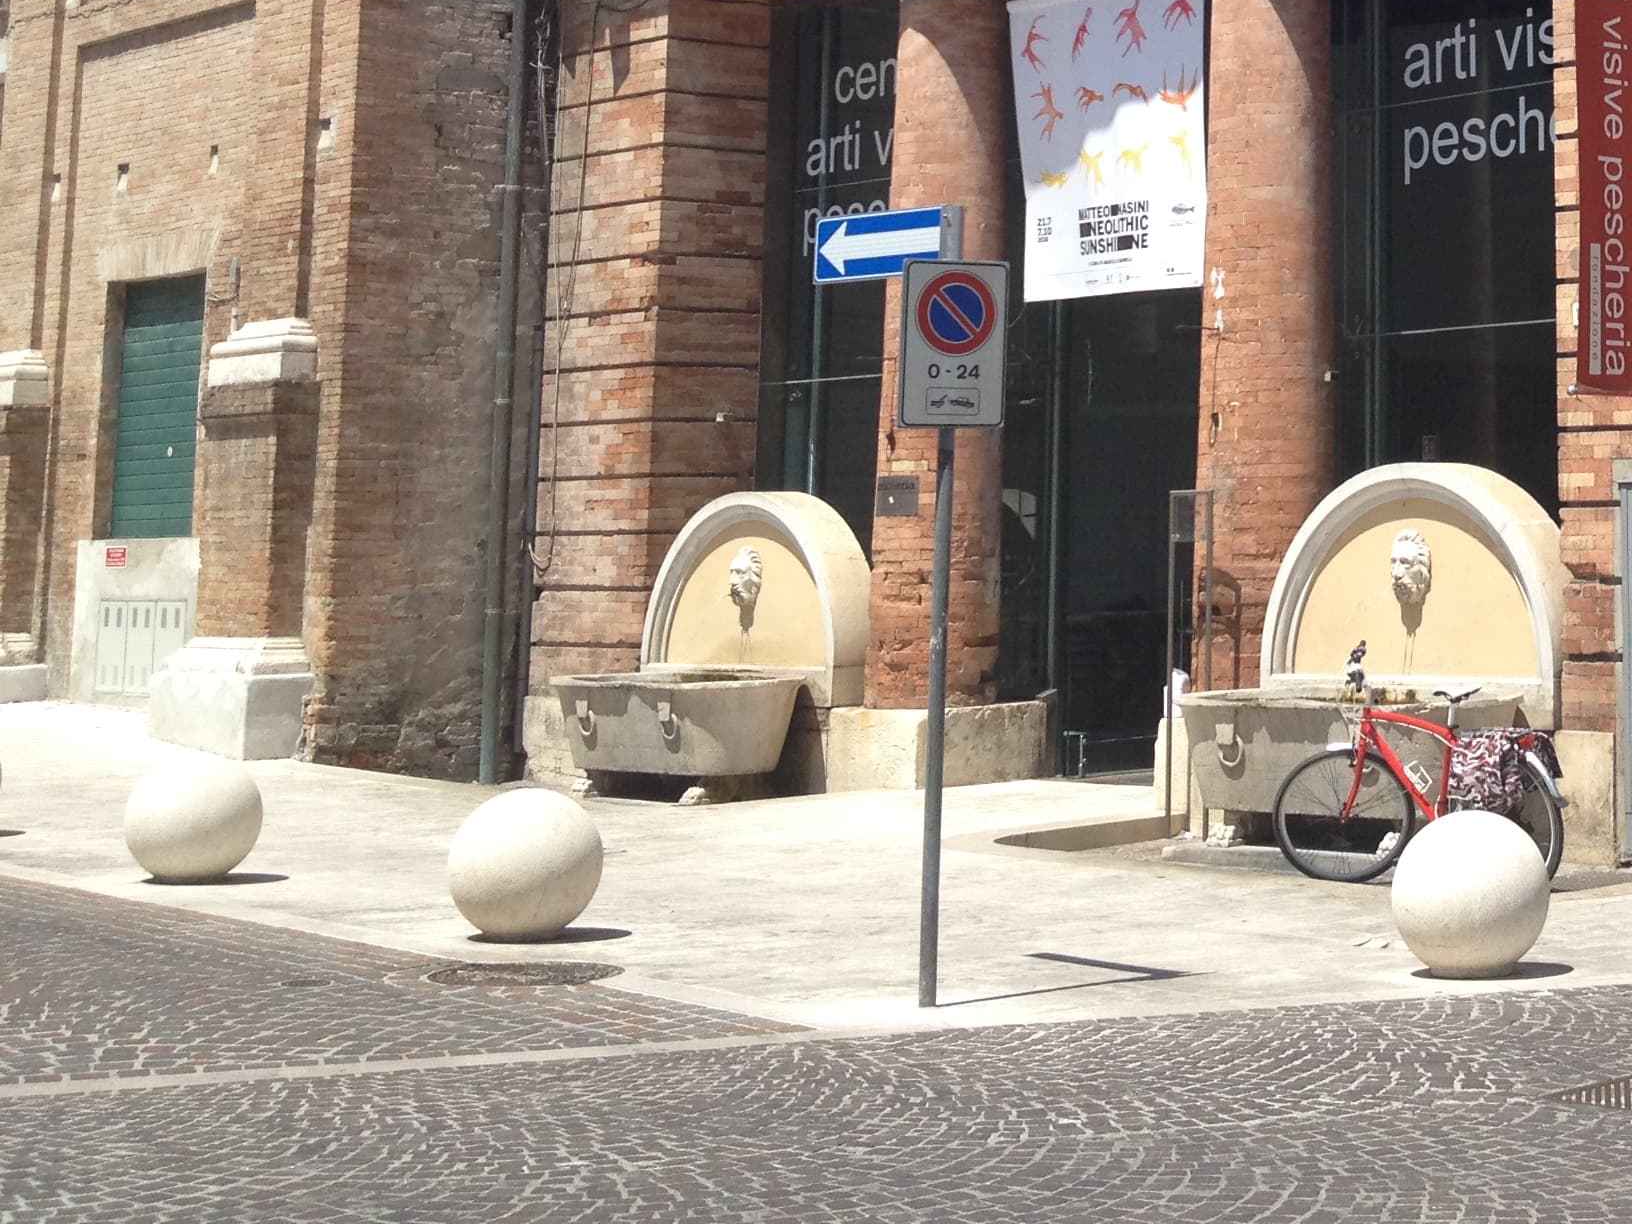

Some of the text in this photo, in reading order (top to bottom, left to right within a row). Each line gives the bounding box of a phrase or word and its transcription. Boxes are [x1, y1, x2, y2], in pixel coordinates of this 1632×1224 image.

[1403, 17, 1477, 89] arti
[1602, 15, 1629, 140] visive
[805, 119, 862, 177] arti
[1403, 95, 1557, 185] pesch
[1078, 205, 1110, 221] MATTEO
[1090, 214, 1149, 236] NEOLITHIC
[1597, 155, 1632, 376] pescheria
